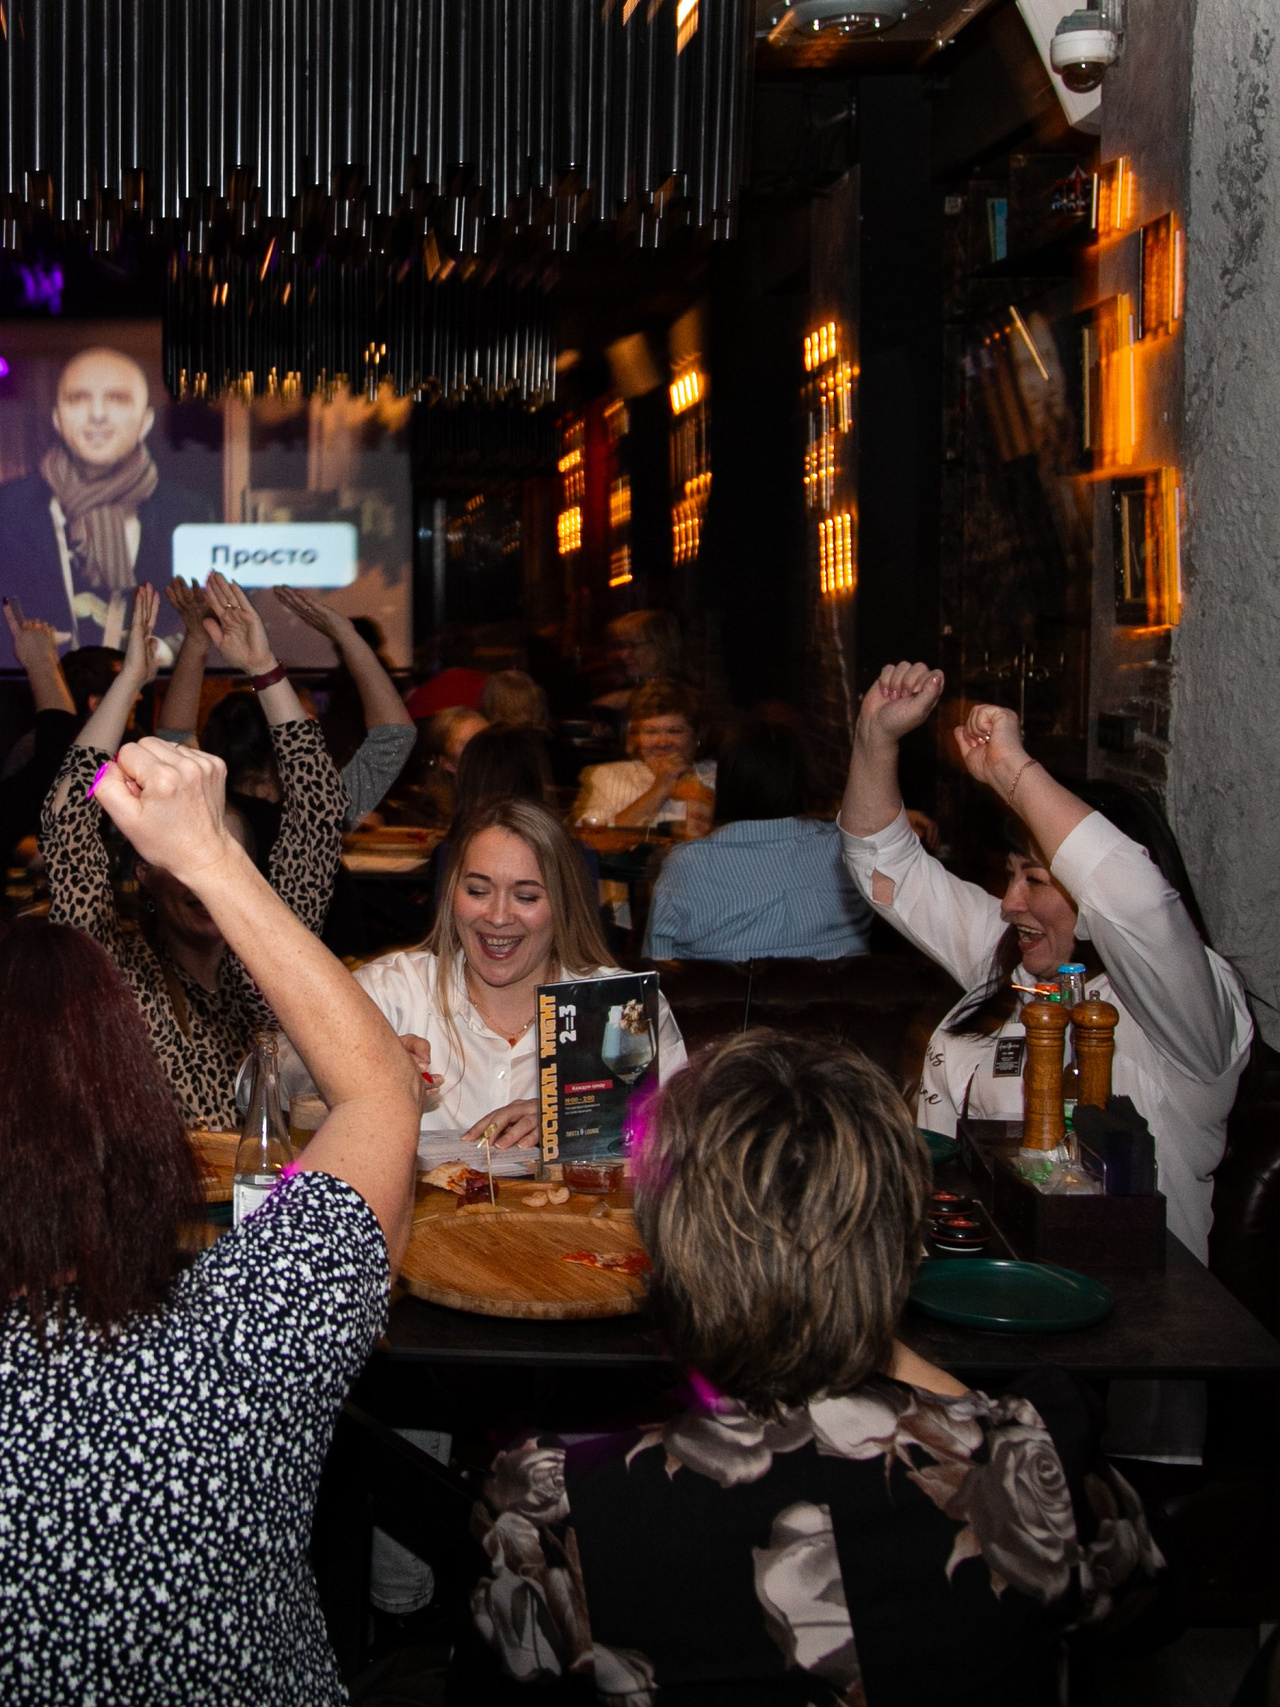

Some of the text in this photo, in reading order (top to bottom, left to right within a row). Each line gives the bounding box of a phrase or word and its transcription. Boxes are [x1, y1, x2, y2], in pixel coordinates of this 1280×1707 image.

[211, 545, 320, 570] Просто
[559, 1004, 577, 1044] 2=3
[539, 993, 559, 1162] COCKTAIL NIGHT
